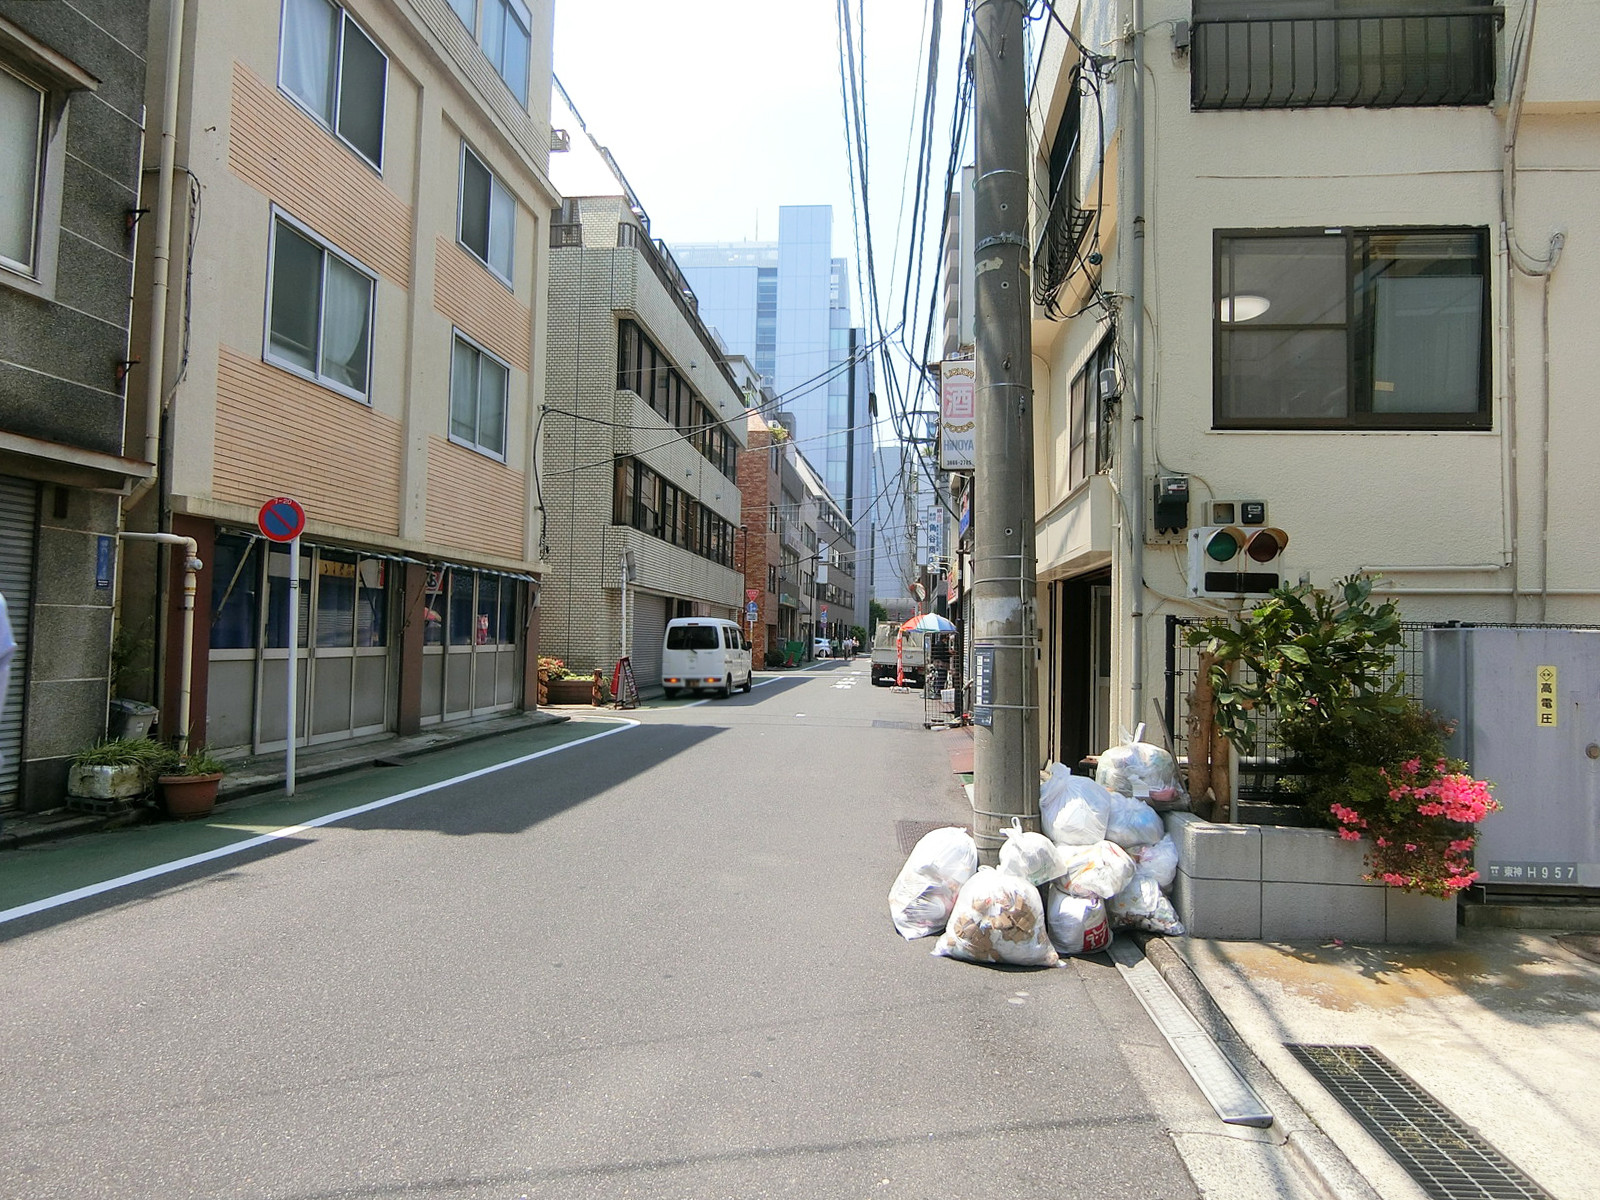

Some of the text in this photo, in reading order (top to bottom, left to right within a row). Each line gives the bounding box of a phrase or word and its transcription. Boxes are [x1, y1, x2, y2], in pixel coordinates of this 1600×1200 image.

[945, 385, 973, 416] 酒
[944, 440, 974, 452] HINOYA
[1541, 682, 1552, 724] 高電圧
